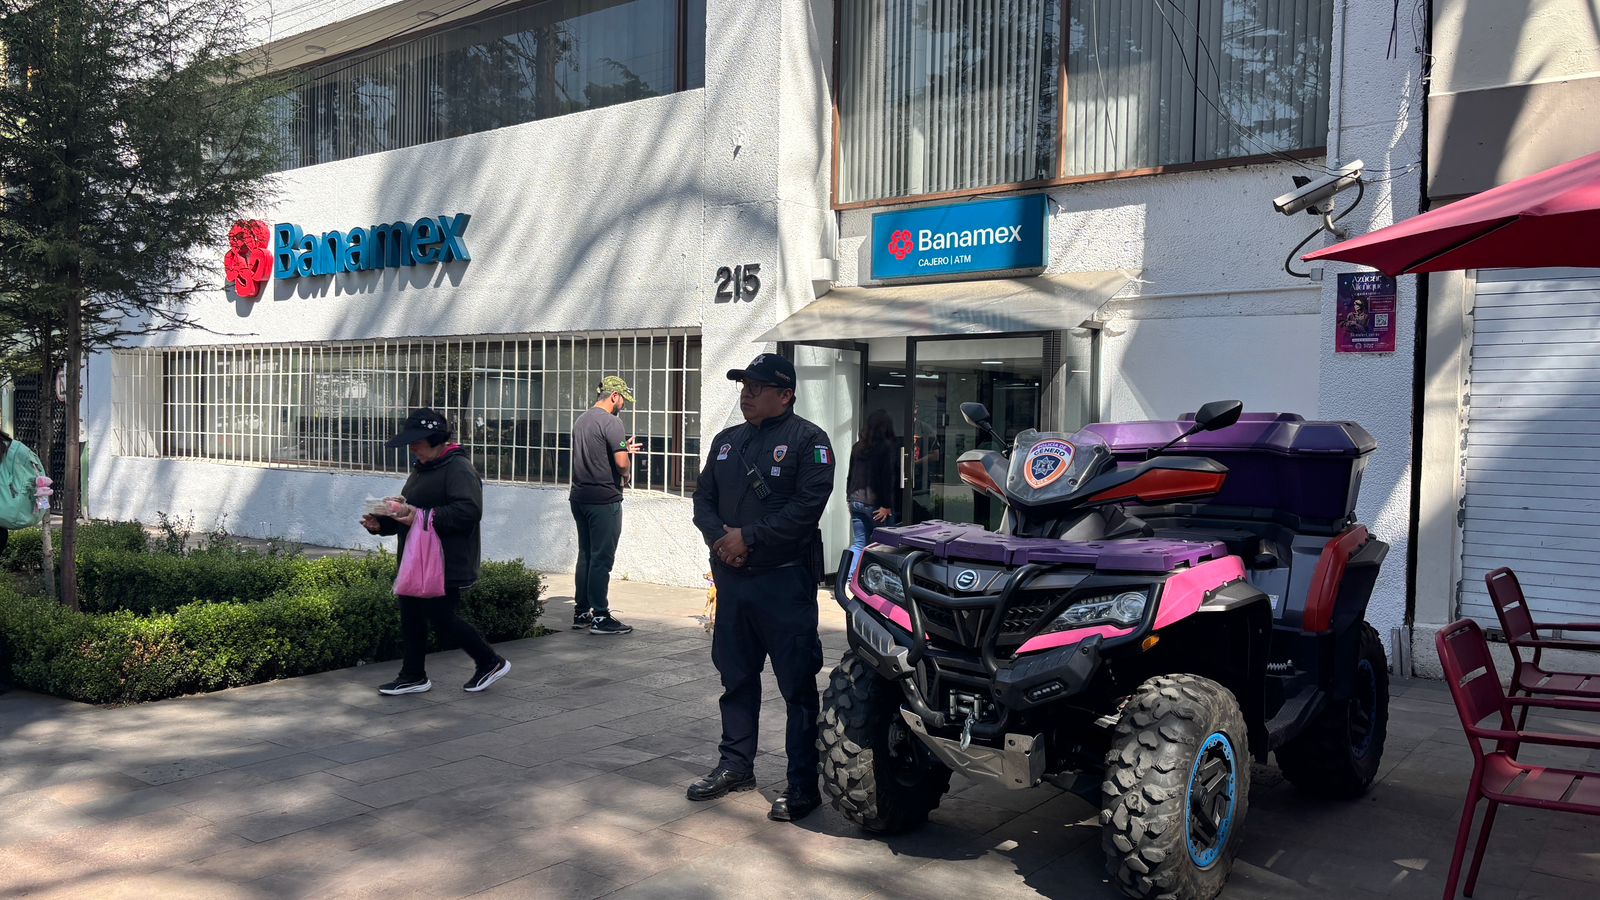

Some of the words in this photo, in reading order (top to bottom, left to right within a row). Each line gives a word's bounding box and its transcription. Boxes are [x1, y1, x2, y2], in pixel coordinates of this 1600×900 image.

[274, 212, 471, 280] Banamex
[918, 224, 1022, 252] Banamex
[918, 257, 949, 267] CAJERO
[954, 255, 972, 264] ATM
[714, 263, 761, 304] 215
